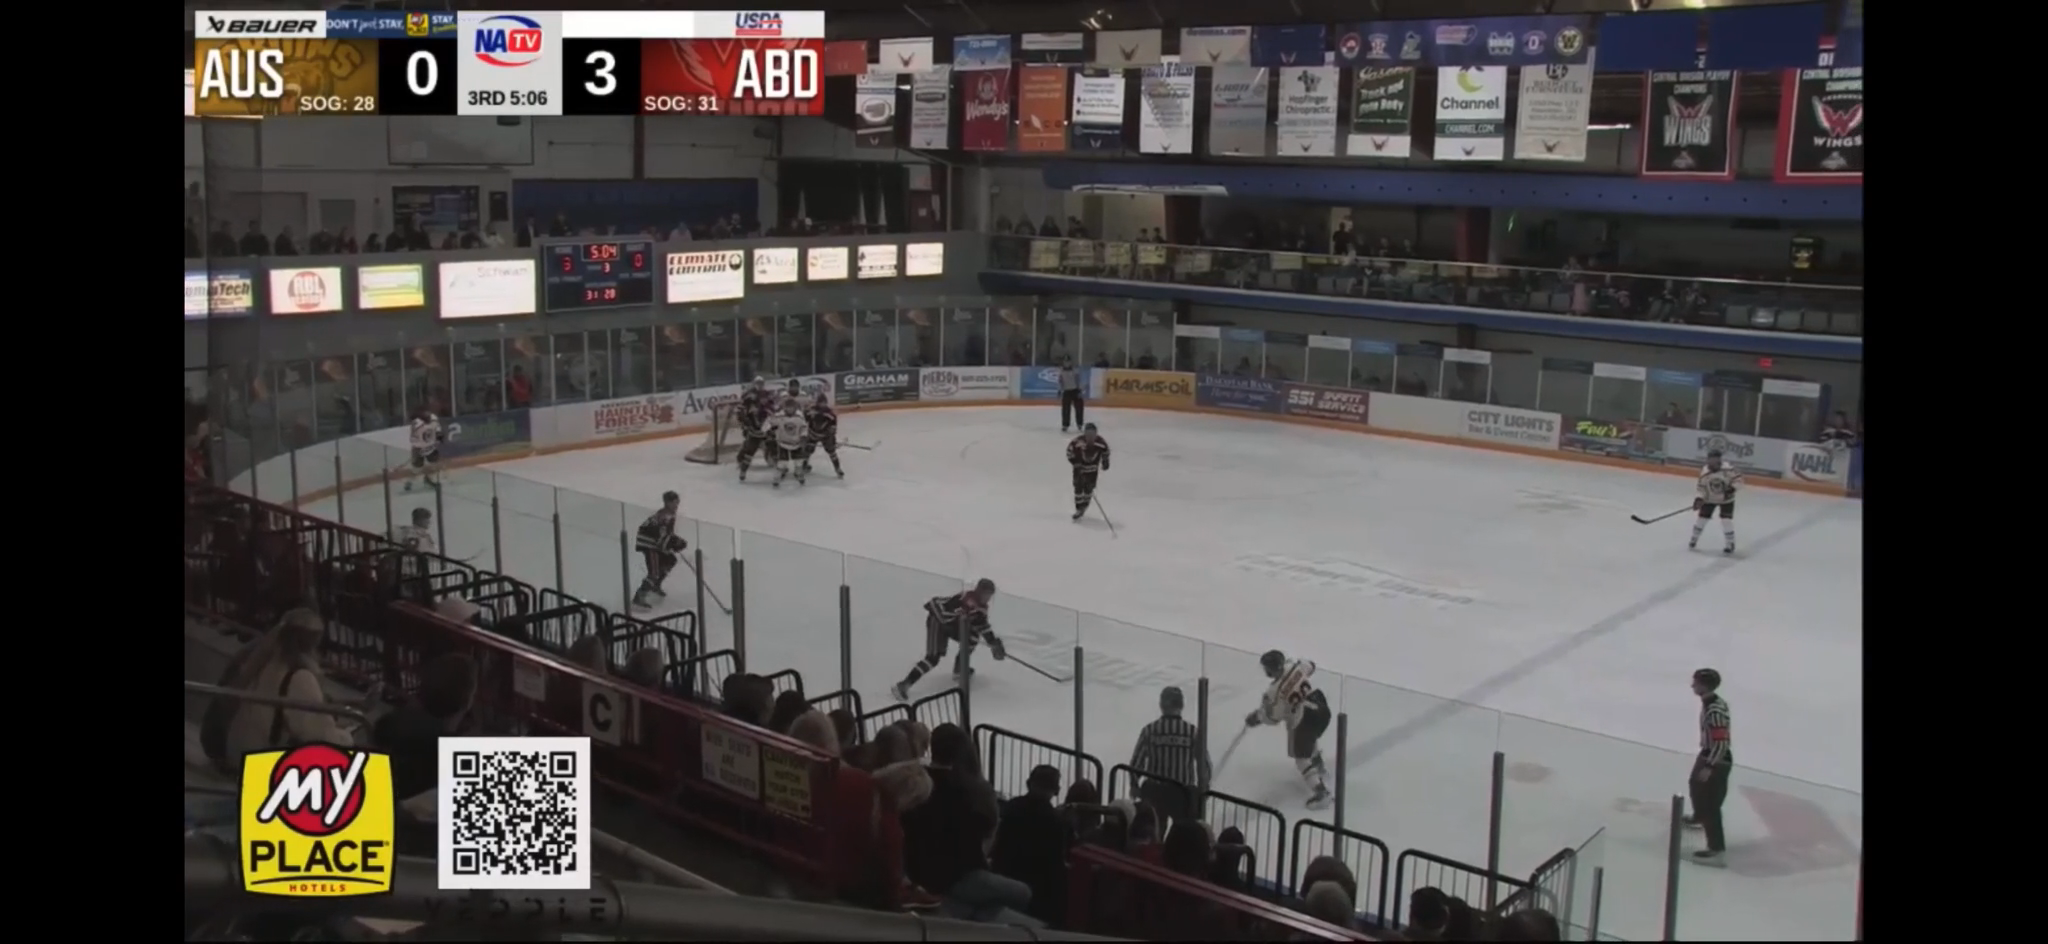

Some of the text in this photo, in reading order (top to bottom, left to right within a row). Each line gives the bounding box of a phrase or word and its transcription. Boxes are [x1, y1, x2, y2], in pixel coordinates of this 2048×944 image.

[966, 97, 1009, 121] Wendy's
[1440, 97, 1500, 110] Channel
[1663, 114, 1712, 147] WINGS
[1813, 134, 1863, 148] WINGS
[603, 262, 611, 273] 3
[843, 374, 909, 385] GRAHAM
[922, 370, 959, 386] PIERSON
[594, 404, 660, 419] HAUNTED
[1317, 401, 1365, 414] SERVICE
[594, 412, 657, 430] FOREST
[1467, 410, 1555, 432] CITY LIGHTS
[1792, 452, 1836, 475] NAHL
[590, 693, 612, 732] C
